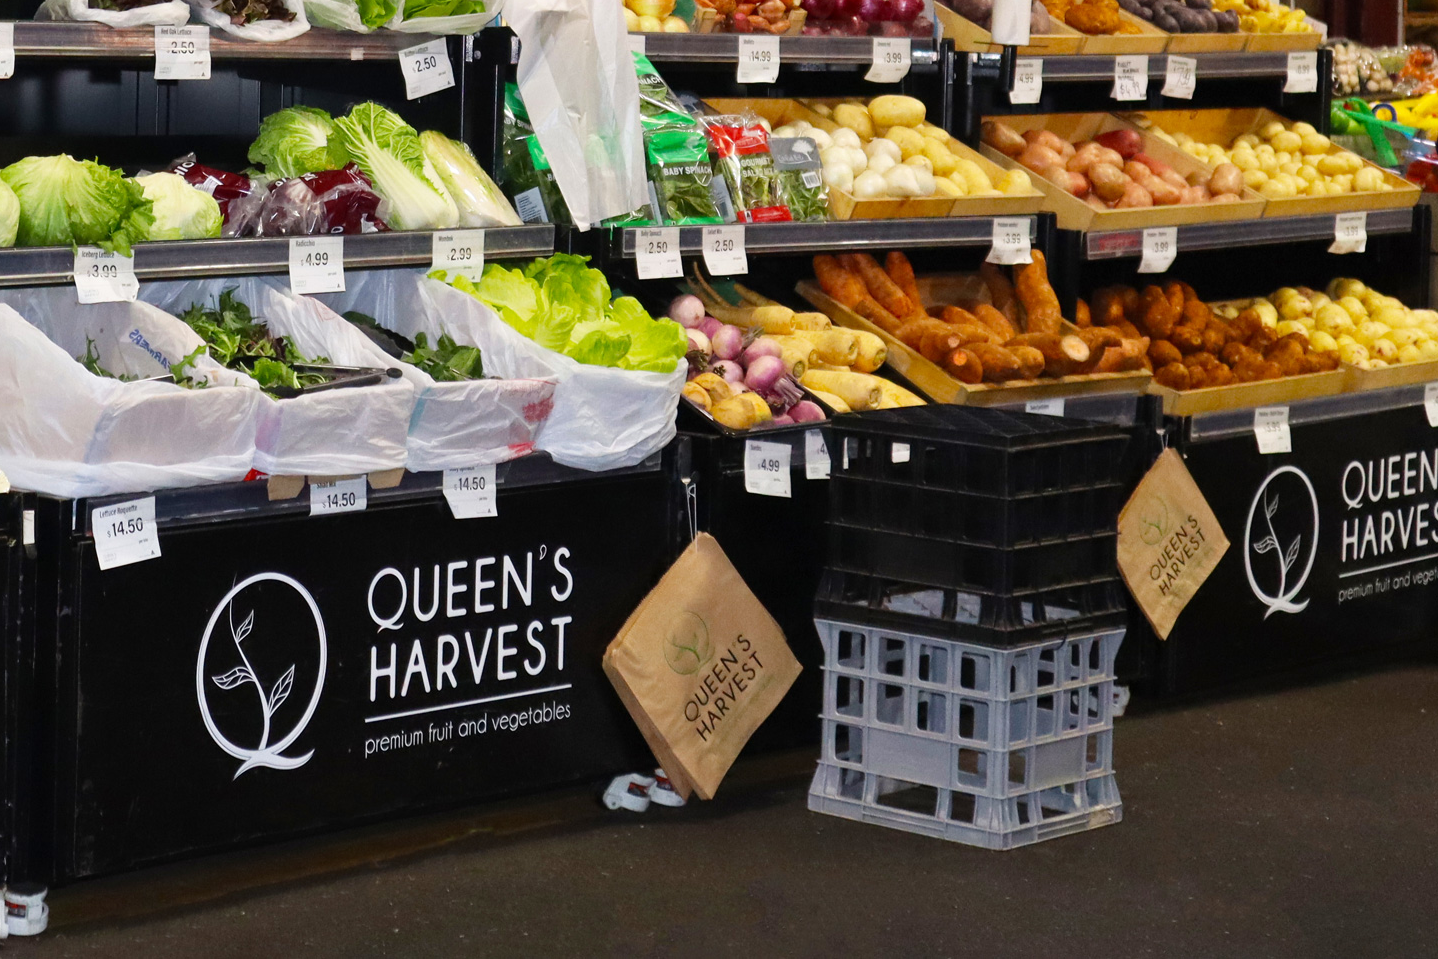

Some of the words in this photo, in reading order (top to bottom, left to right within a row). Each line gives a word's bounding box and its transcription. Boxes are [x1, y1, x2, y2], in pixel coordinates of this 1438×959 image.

[415, 55, 437, 73] 2.50
[663, 165, 684, 176] BABY
[81, 250, 98, 259] Iceberg
[648, 241, 668, 254] 2.50
[714, 239, 734, 252] 2.50
[99, 509, 116, 519] Lettuce
[1158, 526, 1209, 597] HARVEST
[367, 544, 574, 634] QUEEN'S
[1338, 585, 1374, 605] premium
[1375, 578, 1391, 594] fruit
[1392, 572, 1411, 590] and
[370, 616, 572, 703] HARVEST
[683, 633, 752, 722] QUEEN'S
[696, 650, 765, 743] HARVEST
[364, 729, 424, 758] premium
[428, 722, 454, 742] fruit
[458, 715, 487, 737] and
[492, 700, 571, 732] vegetables
